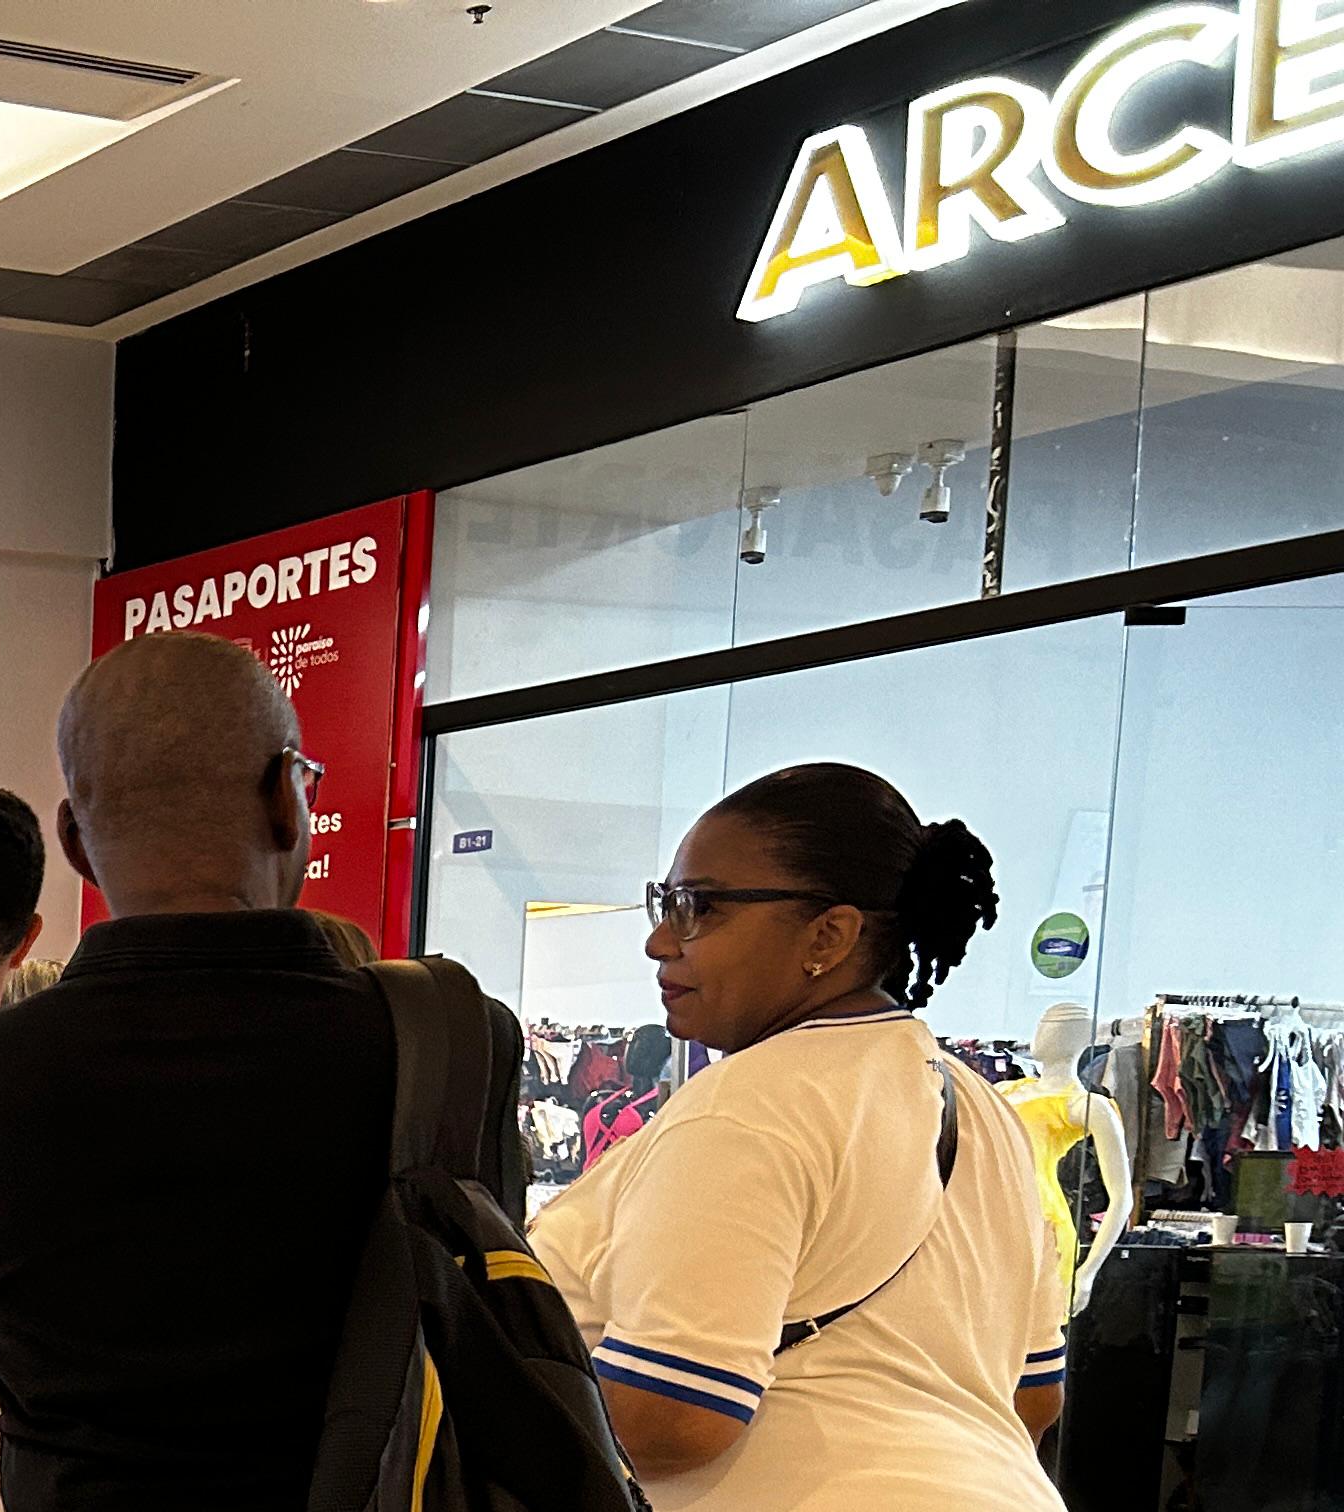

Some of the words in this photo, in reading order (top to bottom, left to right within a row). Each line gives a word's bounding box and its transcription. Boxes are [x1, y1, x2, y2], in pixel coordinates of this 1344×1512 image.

[124, 535, 378, 641] PASAPORTES
[295, 635, 334, 658] paraíso
[295, 656, 308, 670] de
[310, 650, 339, 666] todos
